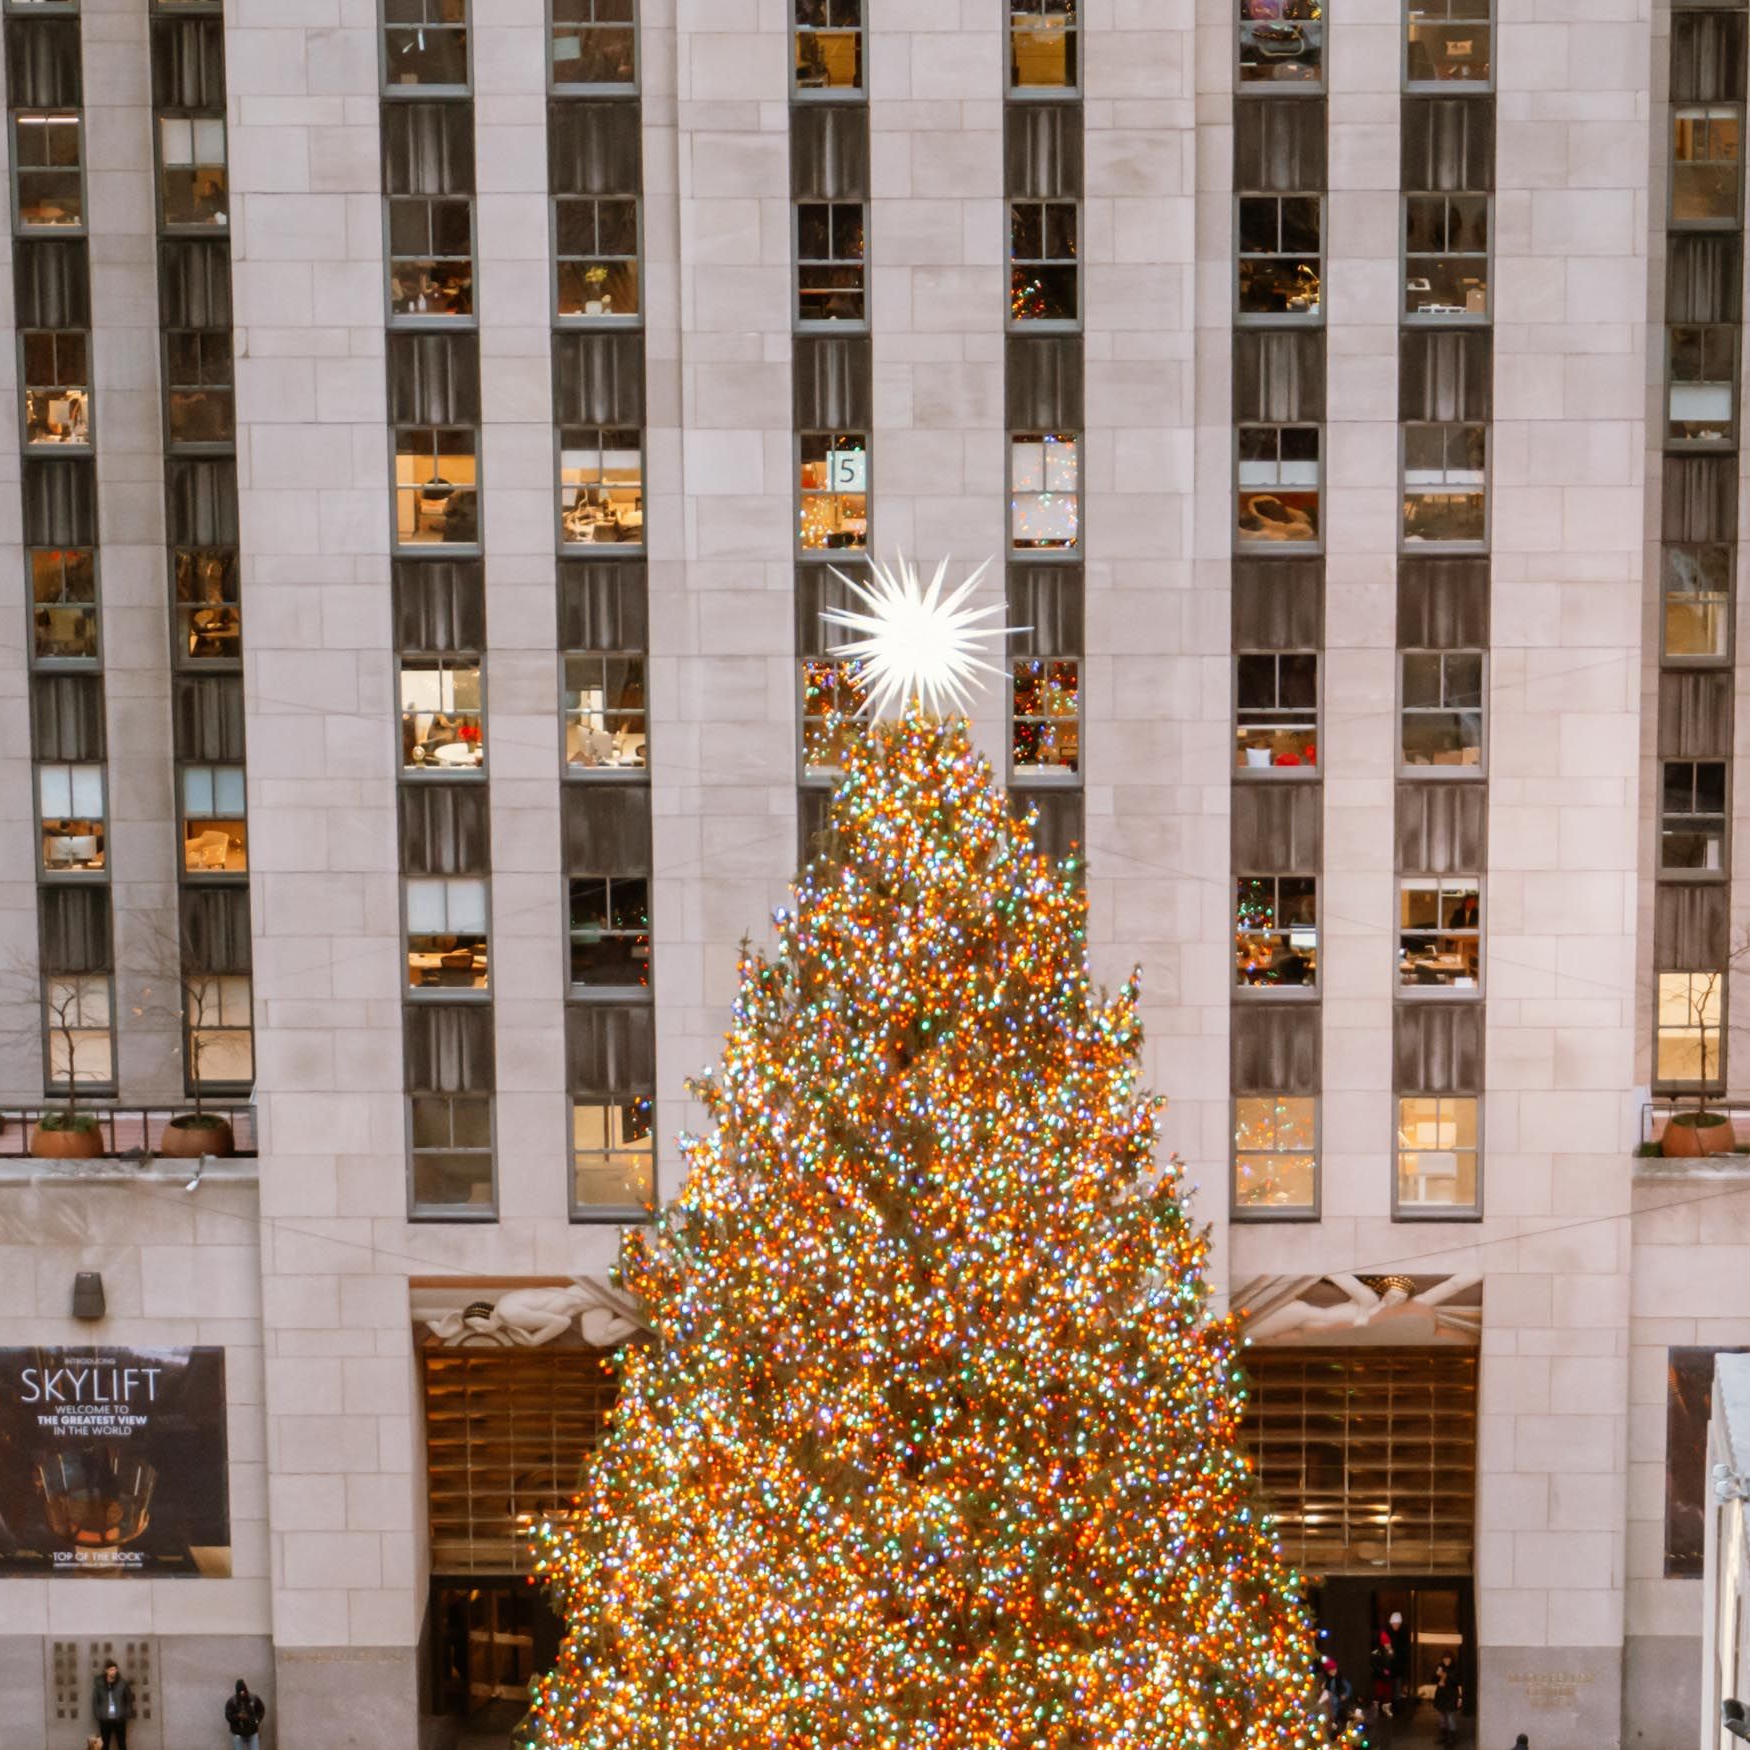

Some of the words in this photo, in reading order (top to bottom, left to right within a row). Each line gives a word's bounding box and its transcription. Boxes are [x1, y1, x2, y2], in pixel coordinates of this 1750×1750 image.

[839, 458, 855, 483] 5
[20, 1368, 162, 1402] SKYLIFT
[55, 1405, 110, 1415] WELCOME
[113, 1405, 130, 1415] TO
[37, 1415, 59, 1425] THE
[60, 1415, 116, 1425] GREATEST
[117, 1415, 148, 1425] VIEW
[53, 1426, 66, 1436] IN
[69, 1426, 89, 1436] THE
[91, 1426, 132, 1436] WORLD
[53, 1552, 73, 1561] TOP
[75, 1552, 88, 1561] OF
[92, 1552, 110, 1561] THE
